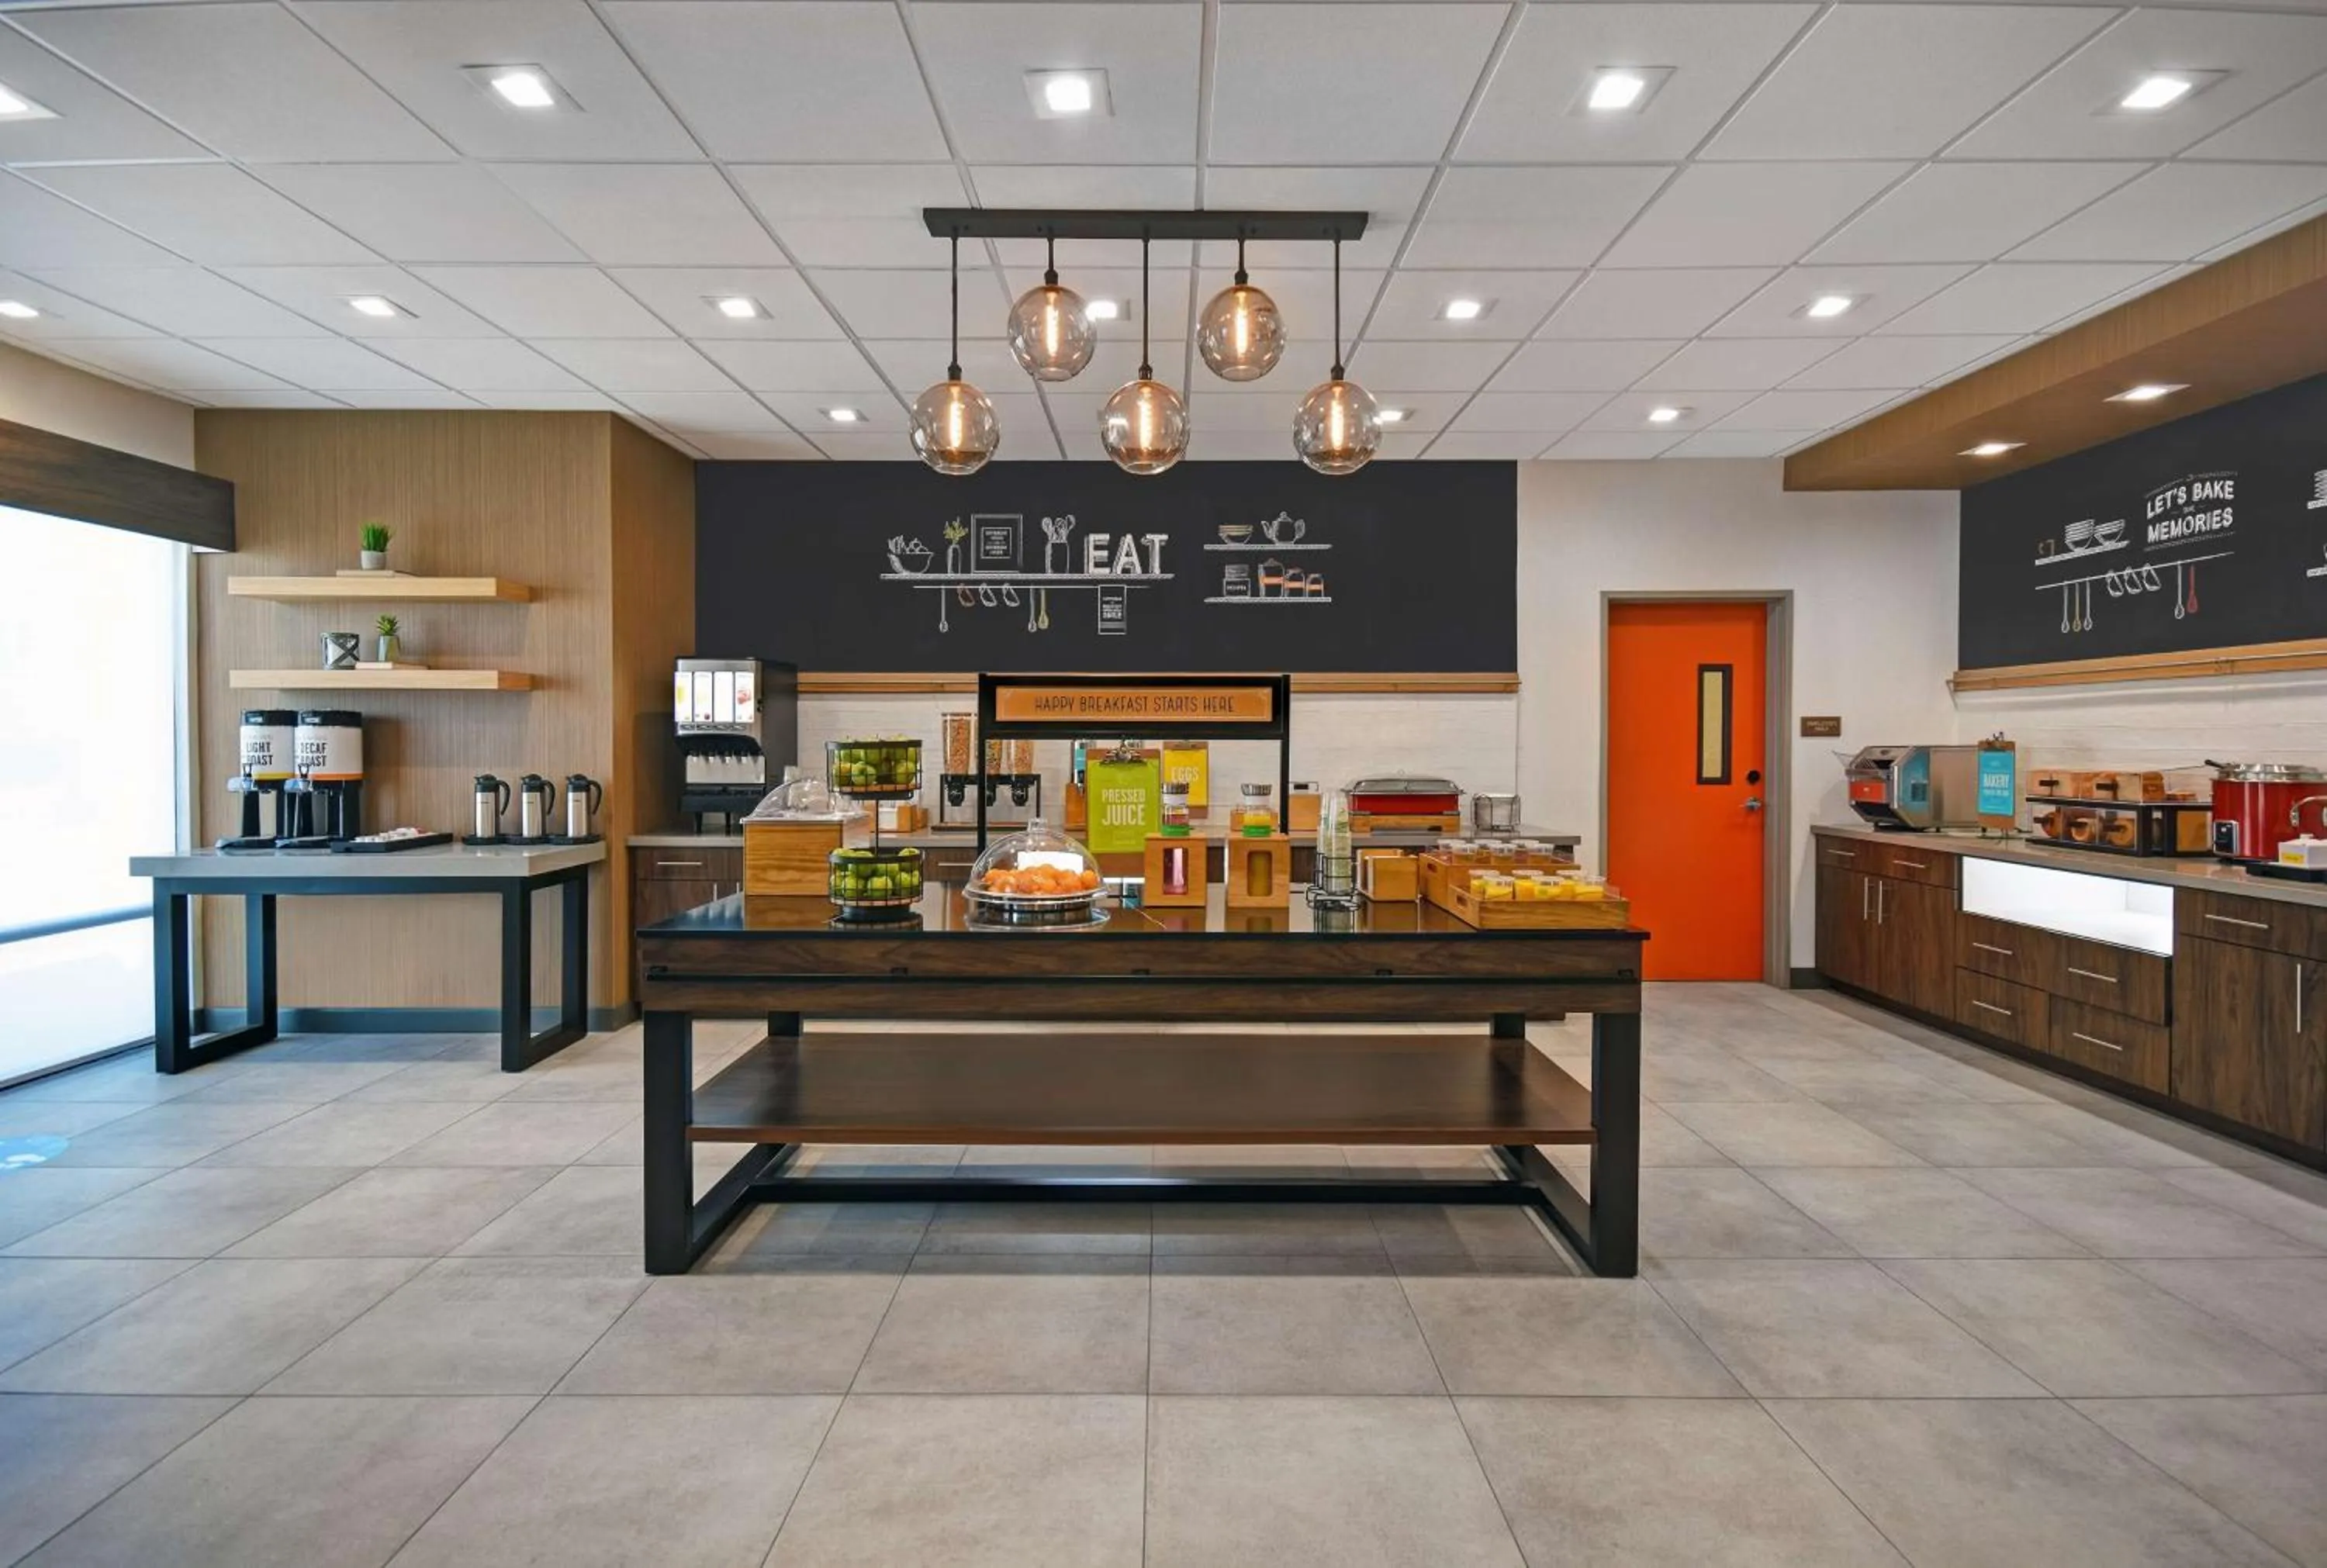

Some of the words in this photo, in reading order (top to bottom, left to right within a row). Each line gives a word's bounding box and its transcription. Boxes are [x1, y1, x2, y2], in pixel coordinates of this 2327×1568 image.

[2146, 486, 2187, 520] LET'S
[2192, 480, 2235, 502] BAKE
[2147, 507, 2233, 544] MEMORIES
[1084, 533, 1169, 574] EAT
[1035, 696, 1075, 712] HAPPY
[1080, 696, 1148, 713] BREAKFAST
[1153, 696, 1198, 713] STARTS
[1203, 696, 1234, 713] HERE
[1171, 766, 1199, 782] EGGS
[1101, 789, 1146, 803] PRESSED
[1101, 804, 1146, 826] JUICE
